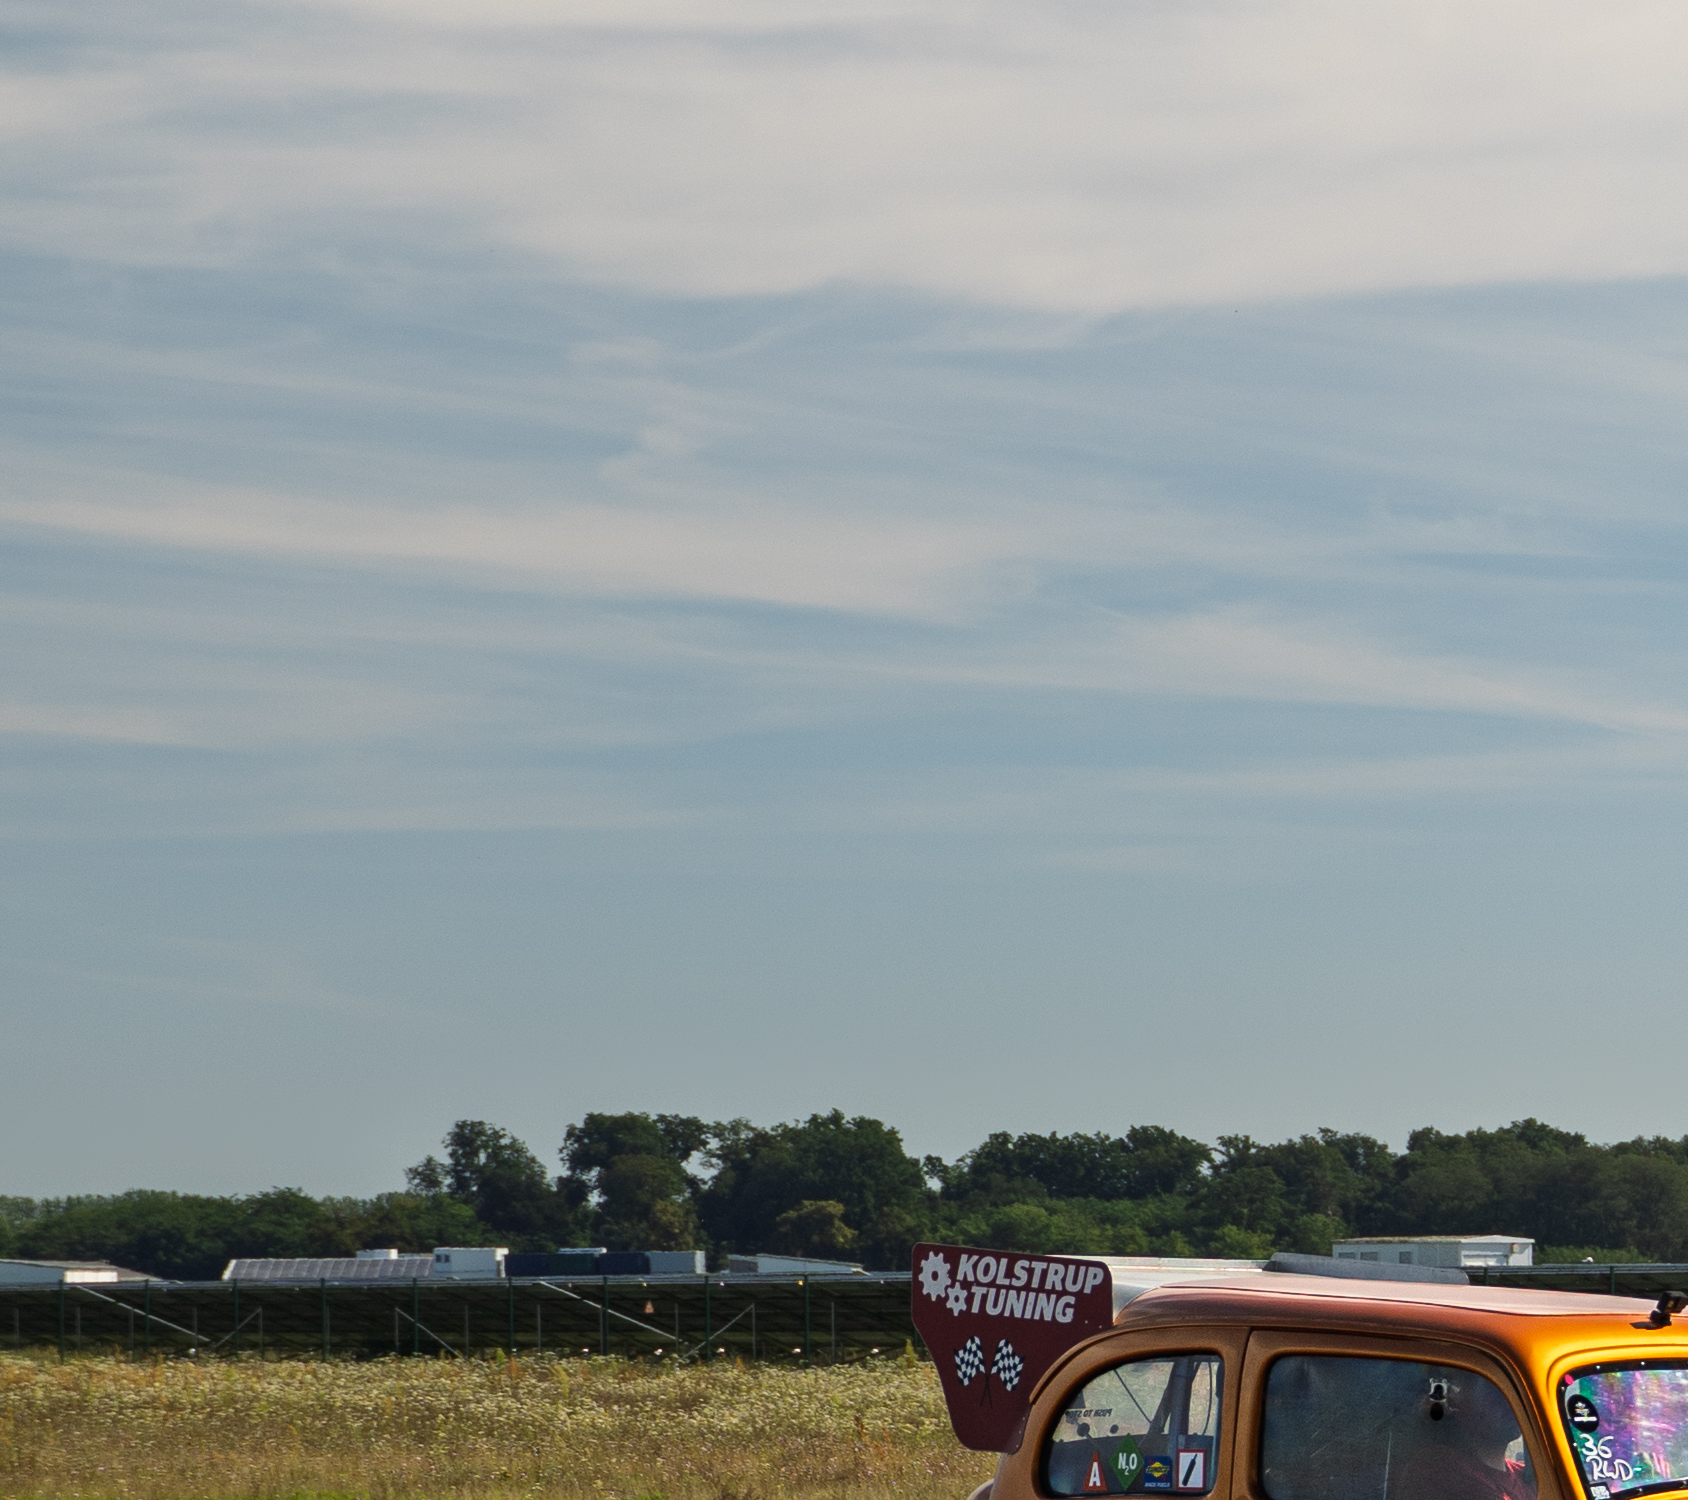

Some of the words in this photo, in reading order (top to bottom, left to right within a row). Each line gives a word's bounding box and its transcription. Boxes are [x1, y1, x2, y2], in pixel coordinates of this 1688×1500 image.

[956, 1254, 1104, 1294] KOLSTRUP
[971, 1285, 1076, 1323] TUNING
[1580, 1433, 1614, 1459] 36
[1088, 1461, 1101, 1487] A
[1586, 1455, 1633, 1481] RWD
